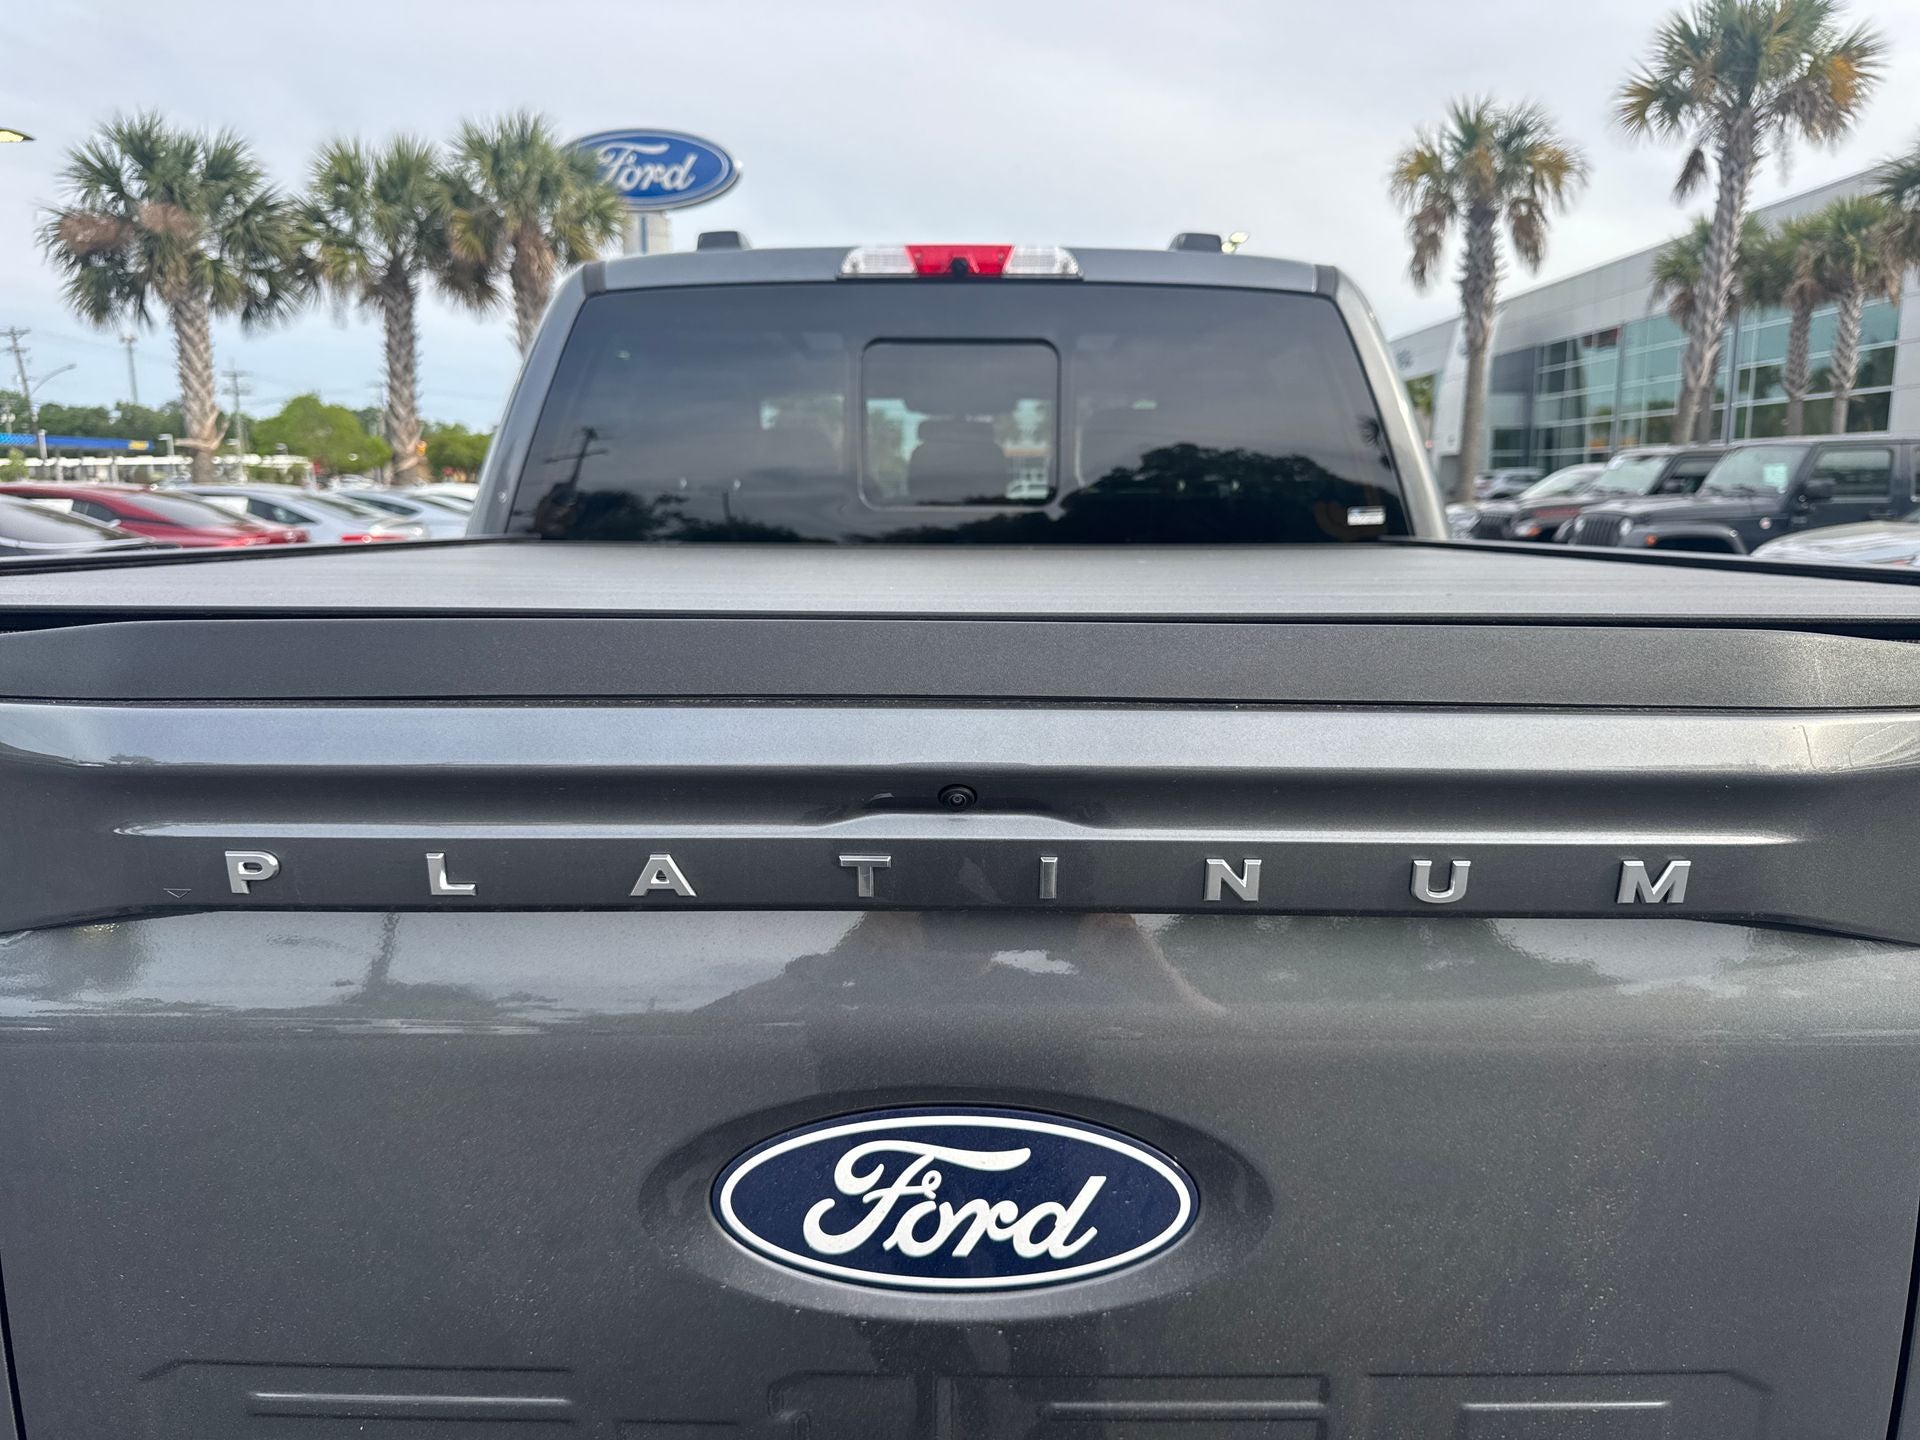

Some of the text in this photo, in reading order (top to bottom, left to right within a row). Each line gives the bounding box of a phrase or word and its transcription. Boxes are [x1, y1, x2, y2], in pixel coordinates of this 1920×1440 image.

[597, 141, 698, 191] Ford
[224, 849, 1692, 905] PLATINUM
[803, 1140, 1107, 1259] Ford
